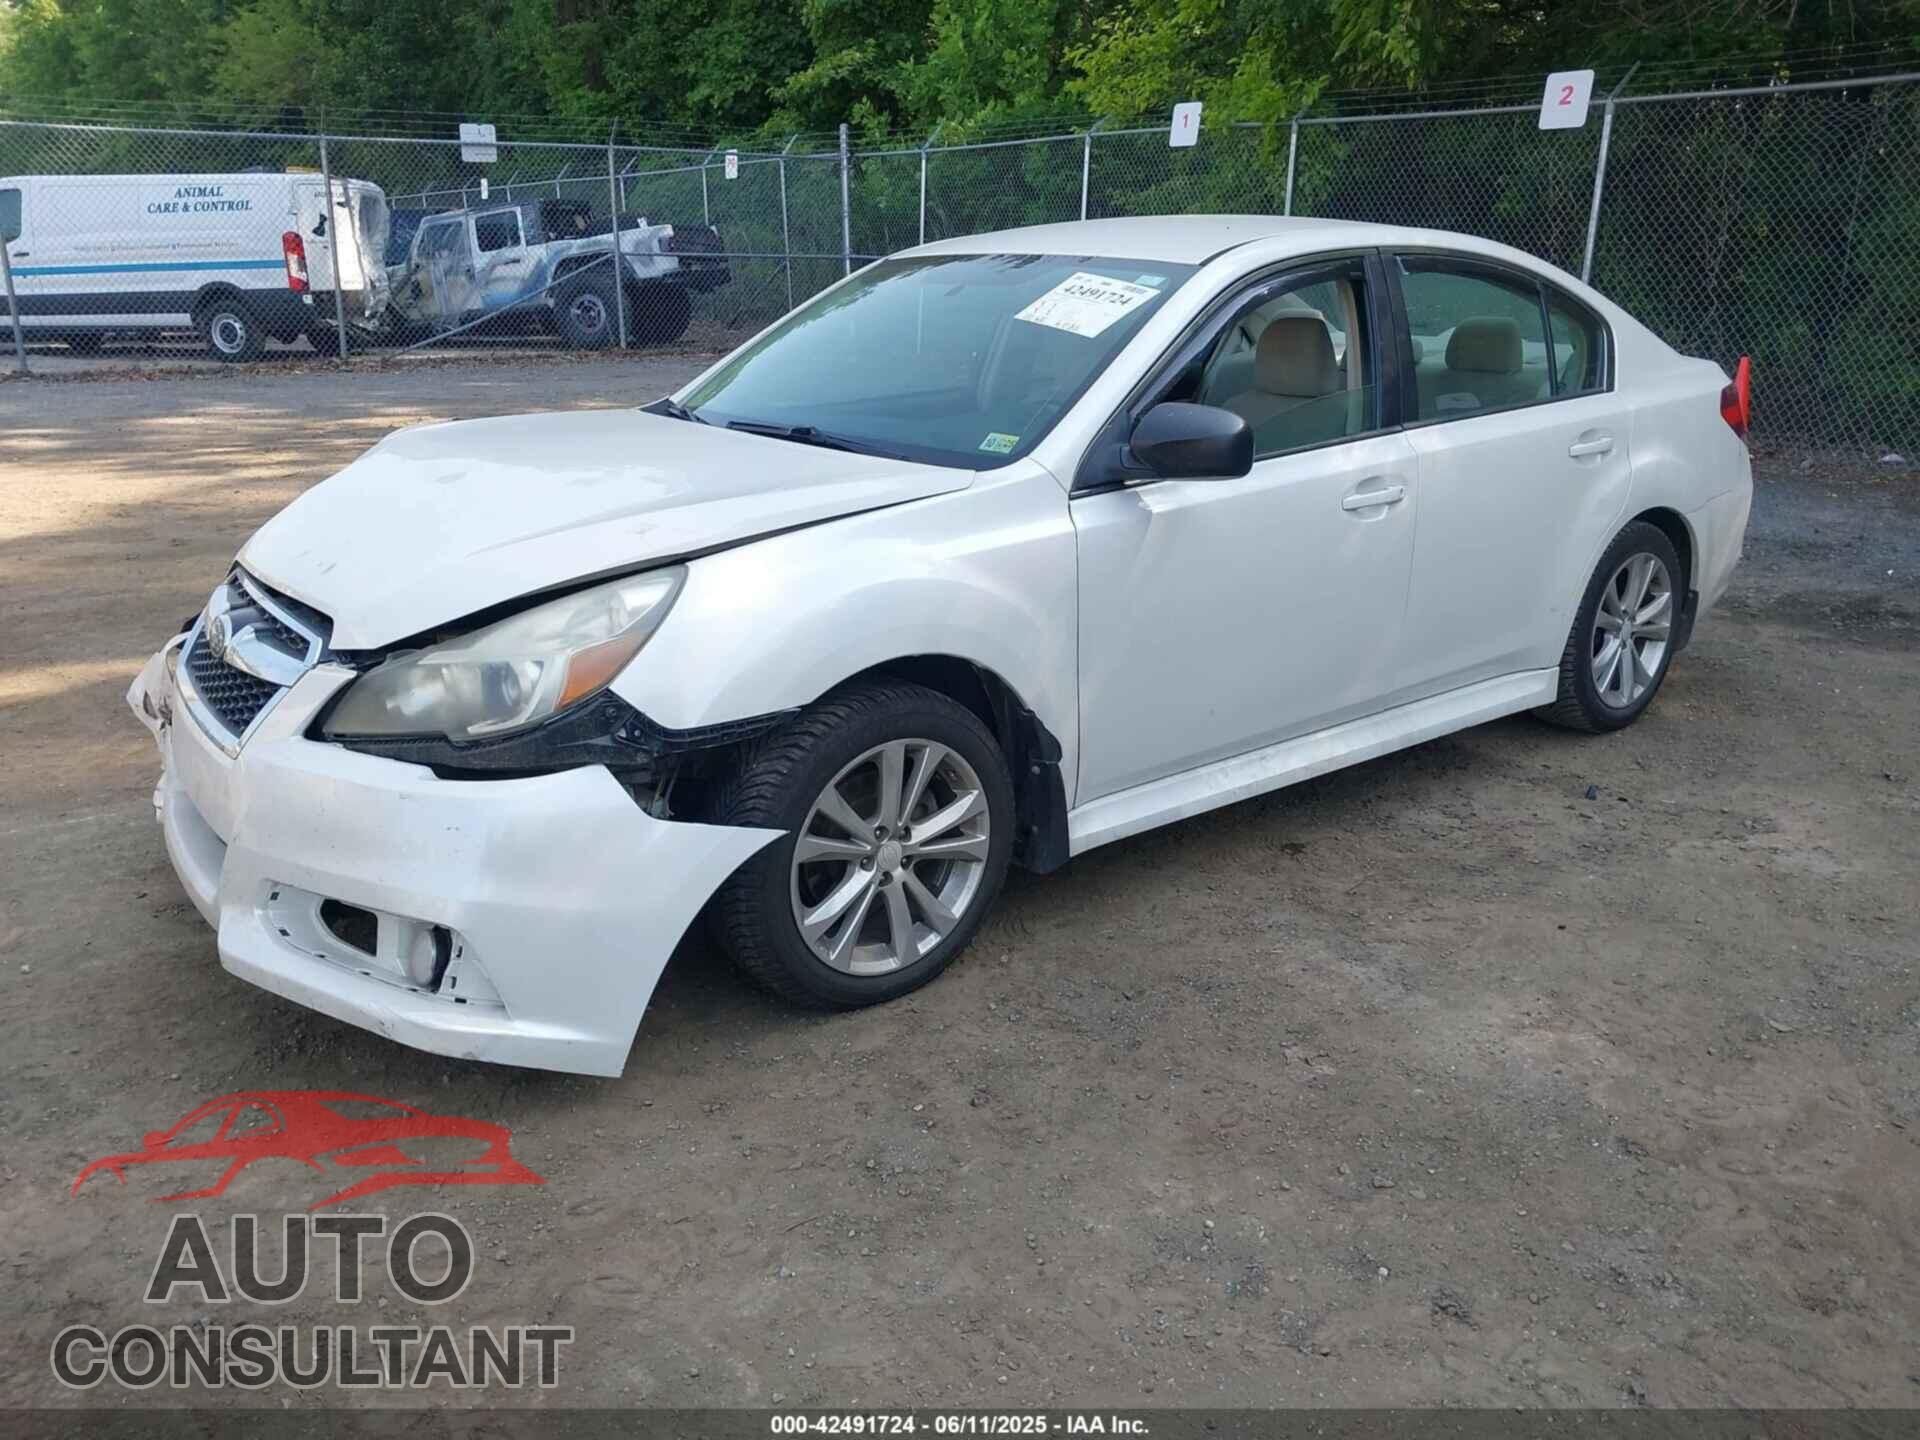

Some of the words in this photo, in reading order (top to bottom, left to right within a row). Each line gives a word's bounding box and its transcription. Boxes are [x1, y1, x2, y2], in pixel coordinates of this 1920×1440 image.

[1558, 84, 1574, 106] 2
[1183, 112, 1189, 128] 1
[174, 186, 224, 198] ANIMAL
[147, 202, 179, 214] CARE
[182, 201, 192, 213] &
[193, 199, 253, 212] CONTROL
[1064, 285, 1133, 306] 42491724
